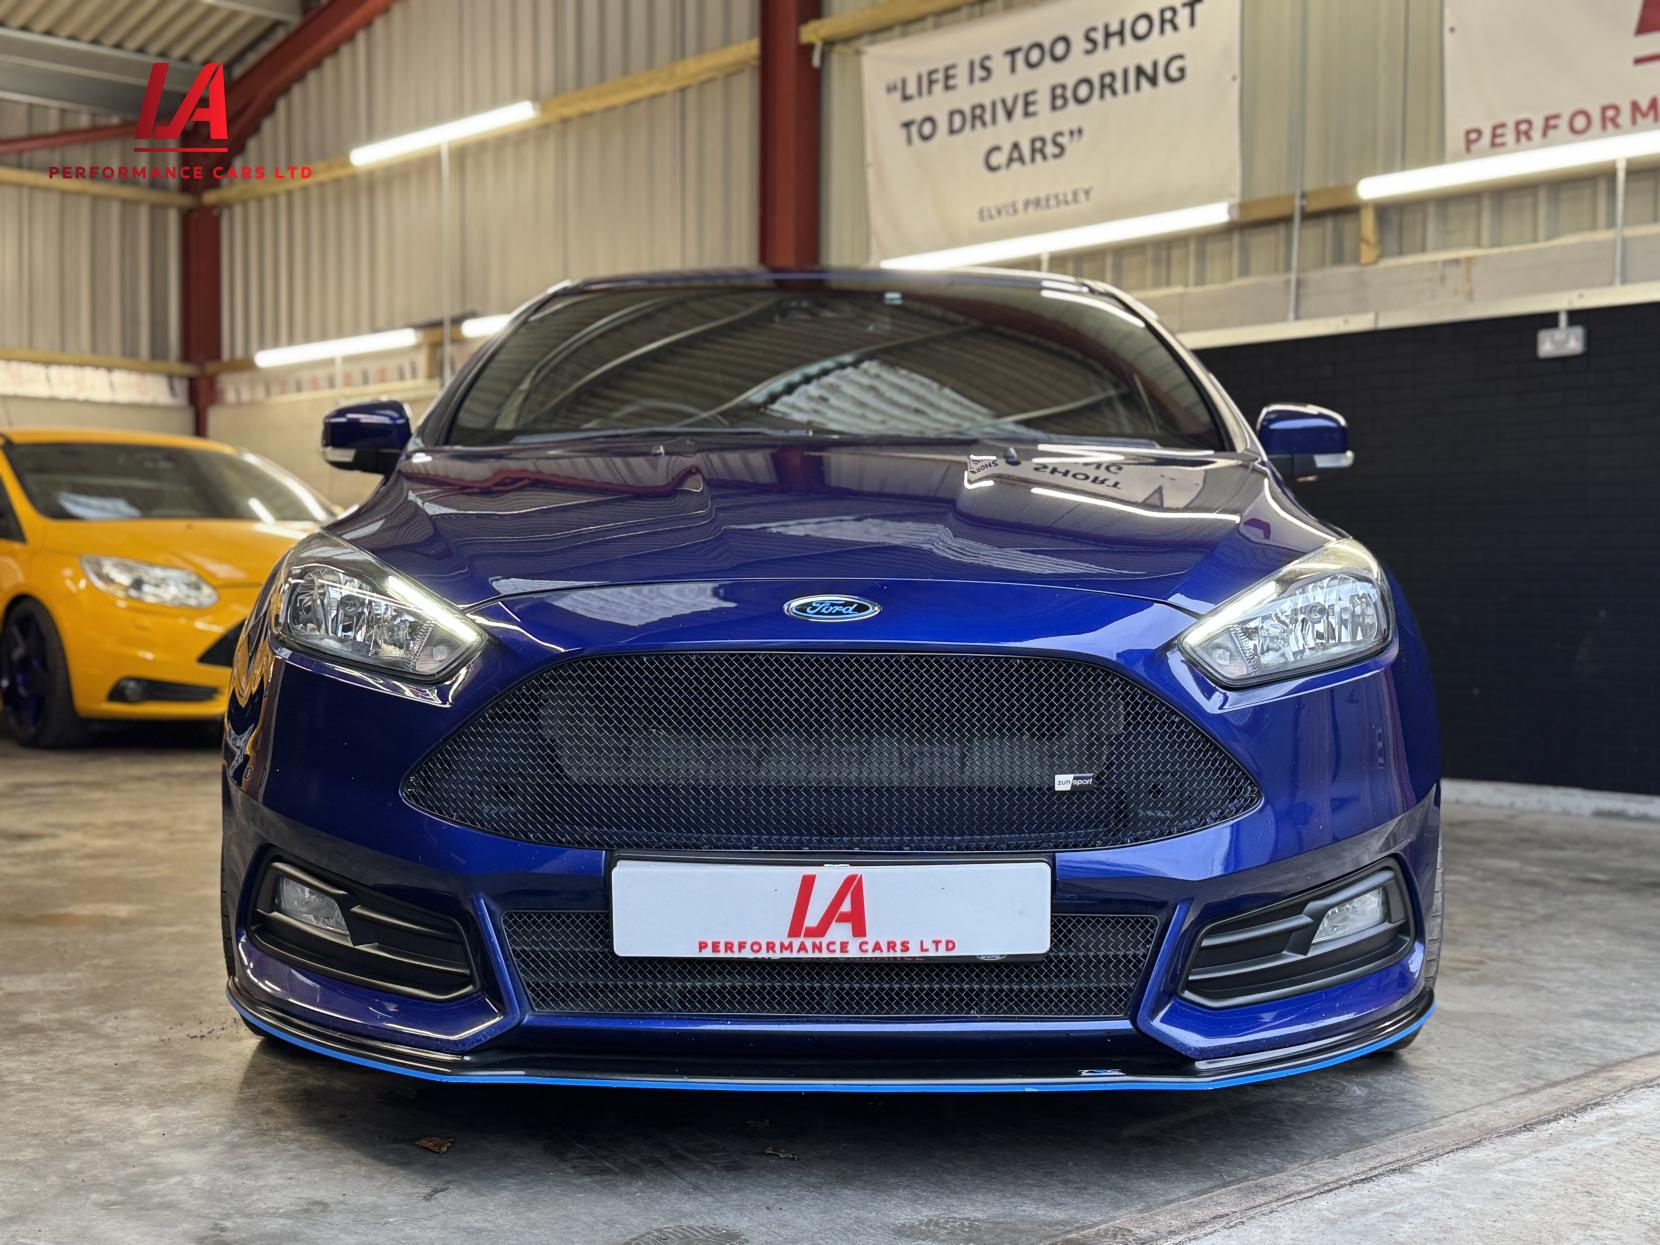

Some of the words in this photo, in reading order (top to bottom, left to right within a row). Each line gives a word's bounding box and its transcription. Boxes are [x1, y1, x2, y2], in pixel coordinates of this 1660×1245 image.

[967, 55, 994, 85] IS
[1003, 35, 1072, 75] TOO
[1083, 0, 1203, 55] SHORT
[900, 116, 938, 147] TO
[947, 90, 1039, 137] DRIVE
[1049, 54, 1187, 112] BORING
[978, 201, 1019, 223] ELVIS
[1022, 186, 1094, 213] PRESLEY
[806, 600, 859, 614] Ford
[698, 940, 850, 954] PERFORMANCE
[858, 940, 911, 954] CARS
[919, 939, 957, 953] LTD
